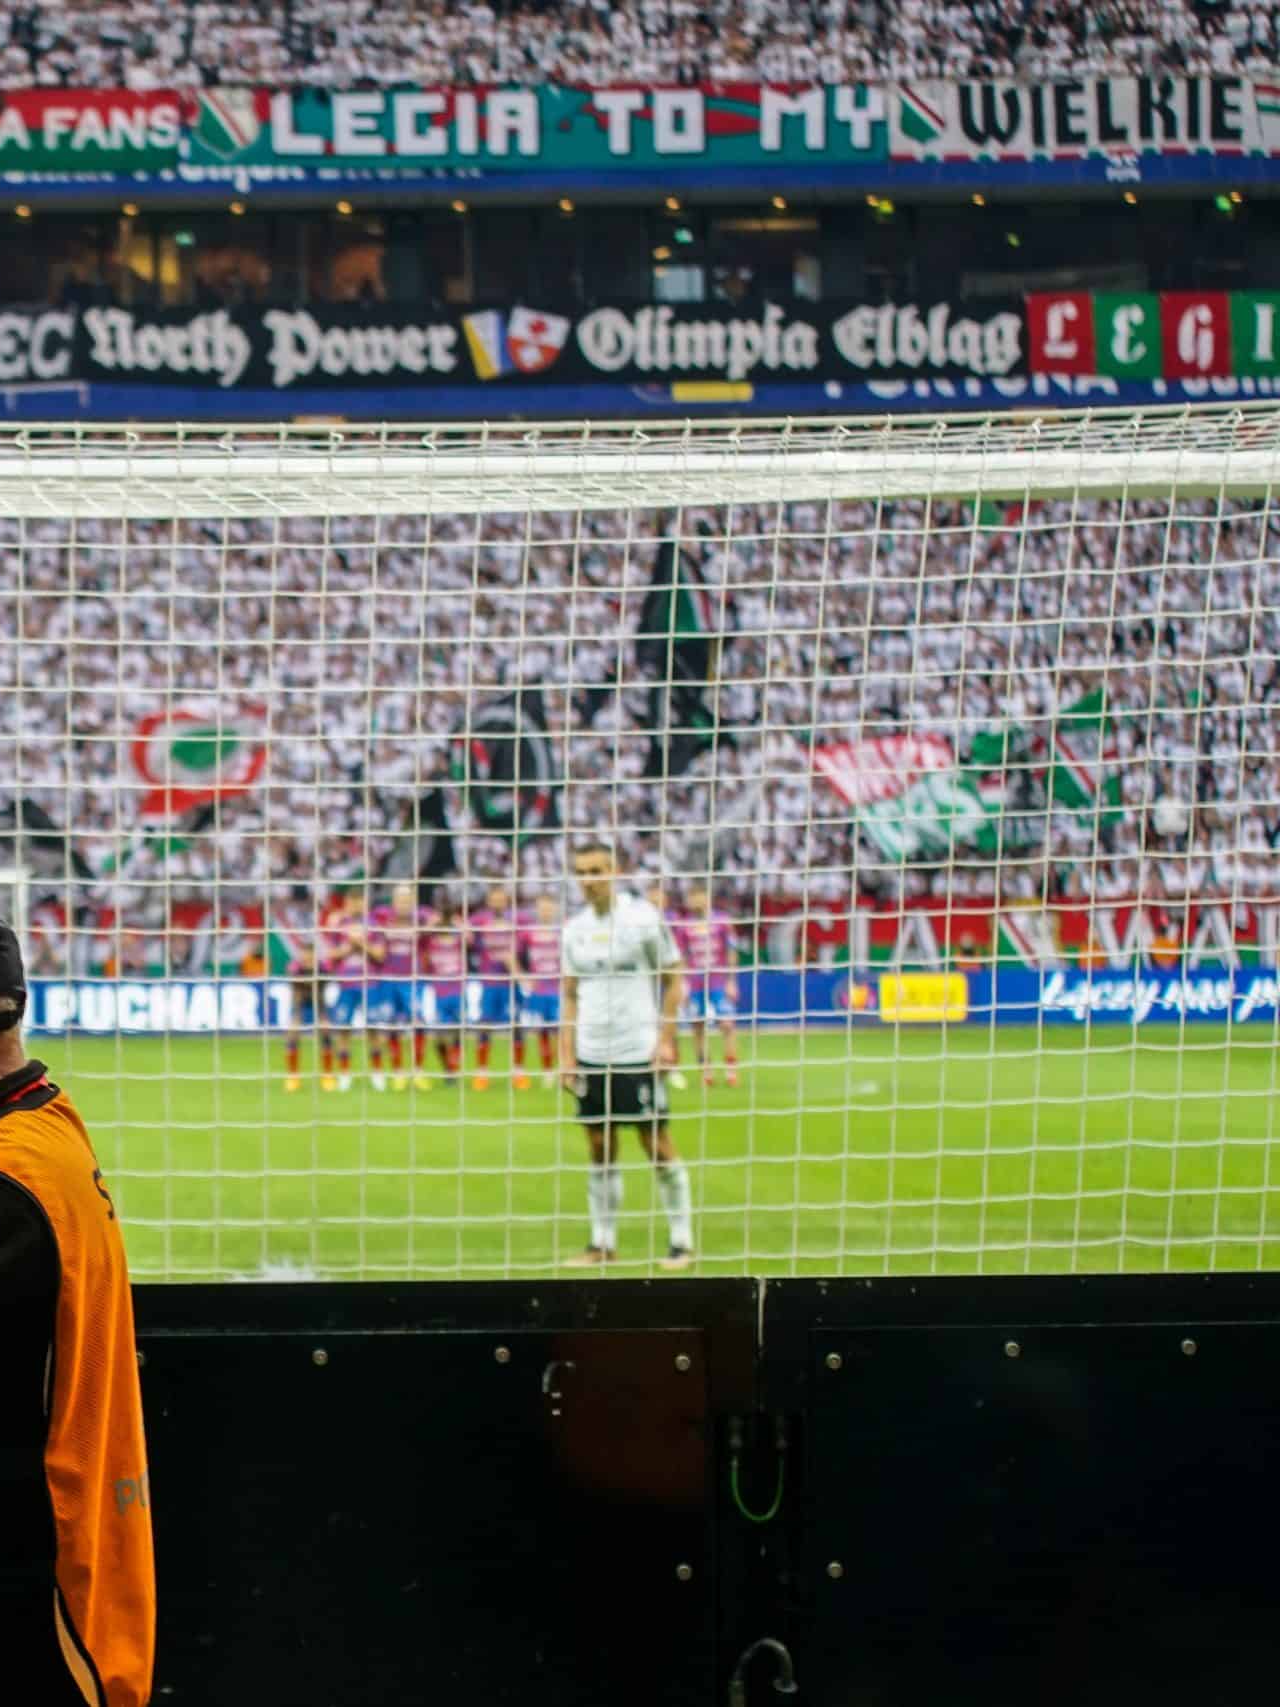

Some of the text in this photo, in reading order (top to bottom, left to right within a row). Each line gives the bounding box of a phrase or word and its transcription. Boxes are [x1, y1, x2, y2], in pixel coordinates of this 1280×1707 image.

[42, 104, 180, 151] FANS
[270, 84, 886, 156] LEGIA TO MY
[960, 74, 1244, 146] WIELKIE
[83, 307, 458, 388] North Power
[577, 304, 818, 380] Olimpia
[45, 982, 263, 1031] PUCHAR
